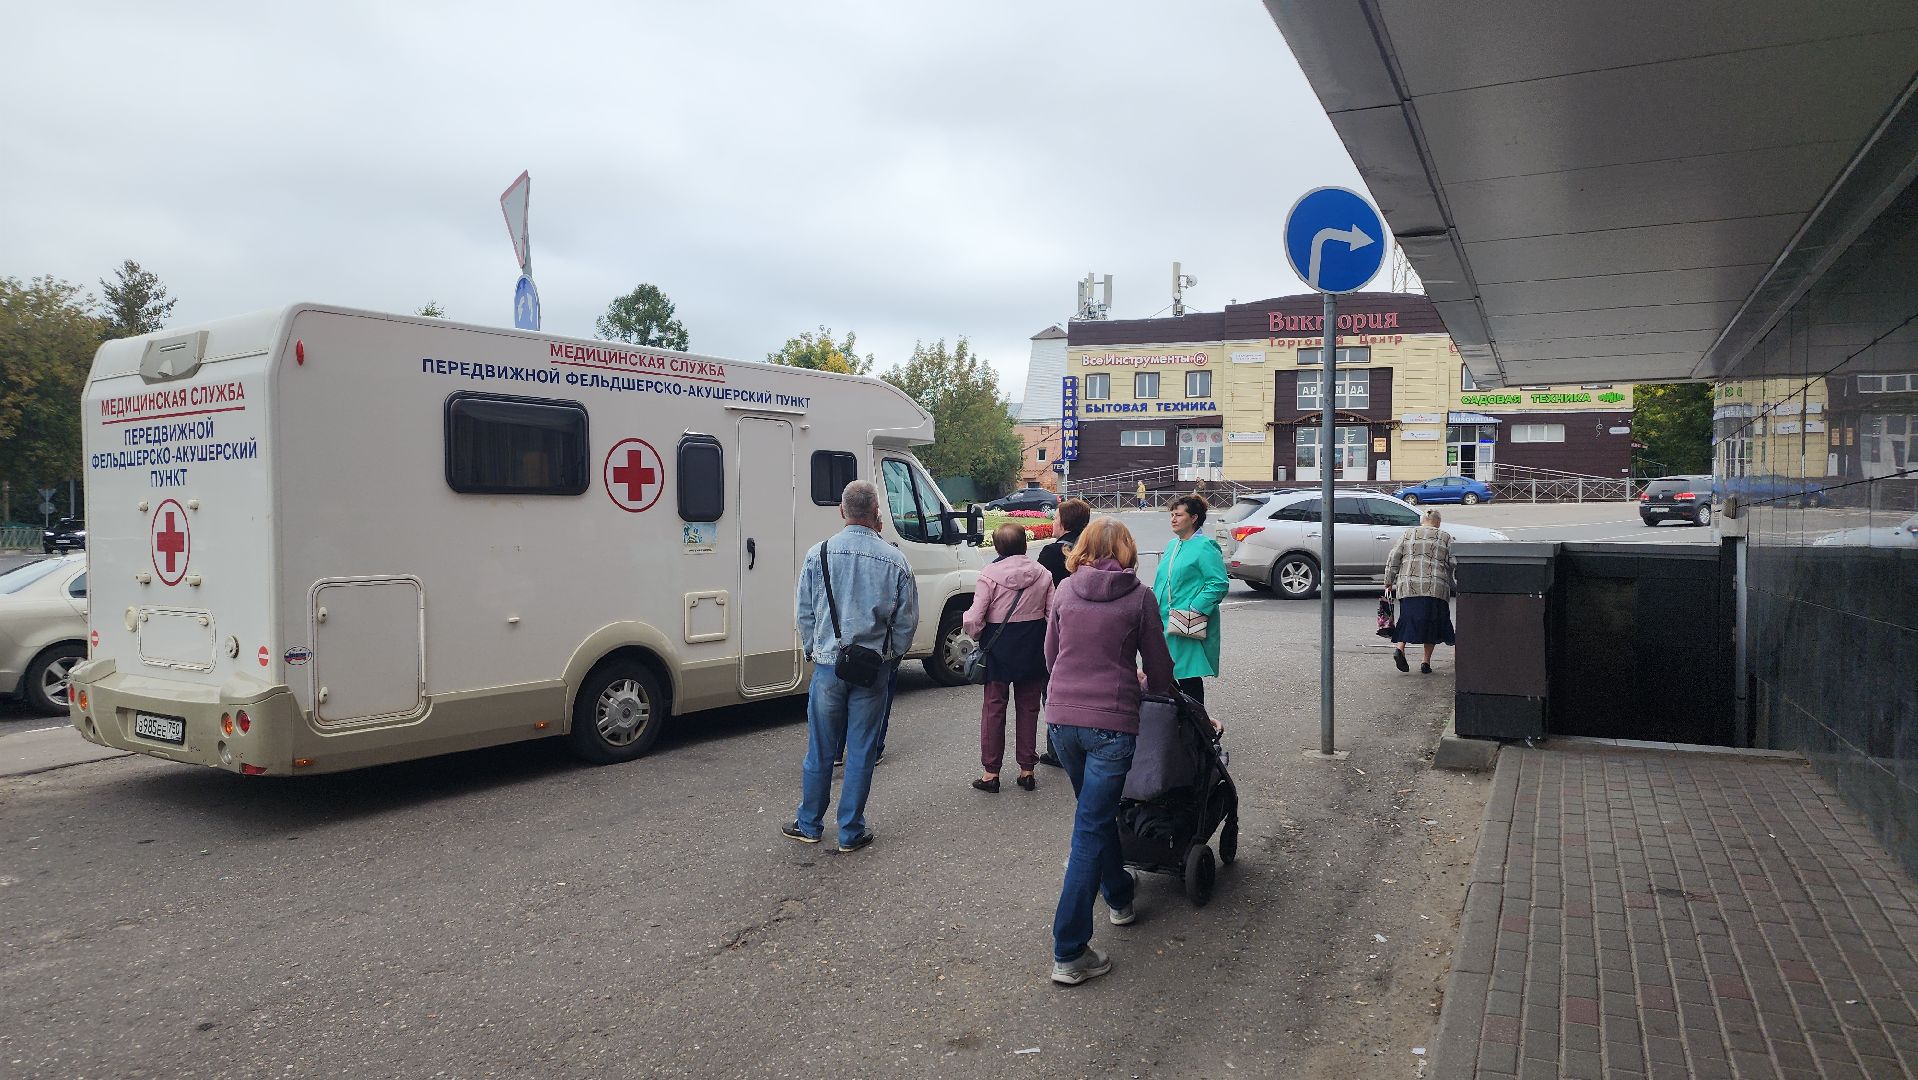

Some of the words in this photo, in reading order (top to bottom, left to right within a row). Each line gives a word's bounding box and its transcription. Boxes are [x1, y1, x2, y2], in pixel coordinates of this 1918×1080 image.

[1268, 312, 1400, 334] Викория
[1269, 335, 1344, 349] Торговй
[1359, 334, 1403, 345] Центр
[550, 343, 665, 370] МЕДИЦИНСКАЯ
[670, 359, 726, 378] СЛУЖБА
[422, 358, 560, 384] ПЕРЕДВИЖНОЙ
[565, 371, 772, 403] ФЕЛЬДШЕРСКО-АКУШЕРСКИЙ
[775, 393, 811, 408] ПУНКТ
[1302, 385, 1364, 395] АРНДА
[101, 389, 187, 417] МЕДИЦИНСКАЯ
[190, 382, 245, 405] СЛУЖБА
[1085, 402, 1148, 413] БЫТОВАЯ
[1156, 401, 1217, 412] ТЕХНИКА
[1461, 394, 1521, 406] САДОВАЯ
[1531, 392, 1591, 404] ТЕХНИКА
[124, 416, 214, 446] ПЕРЕДВИЖНОЙ
[92, 437, 257, 470] ФЕЛЬДШЕРСКО-АКУШЕРСКИЙ
[150, 468, 188, 488] ПУНКТ
